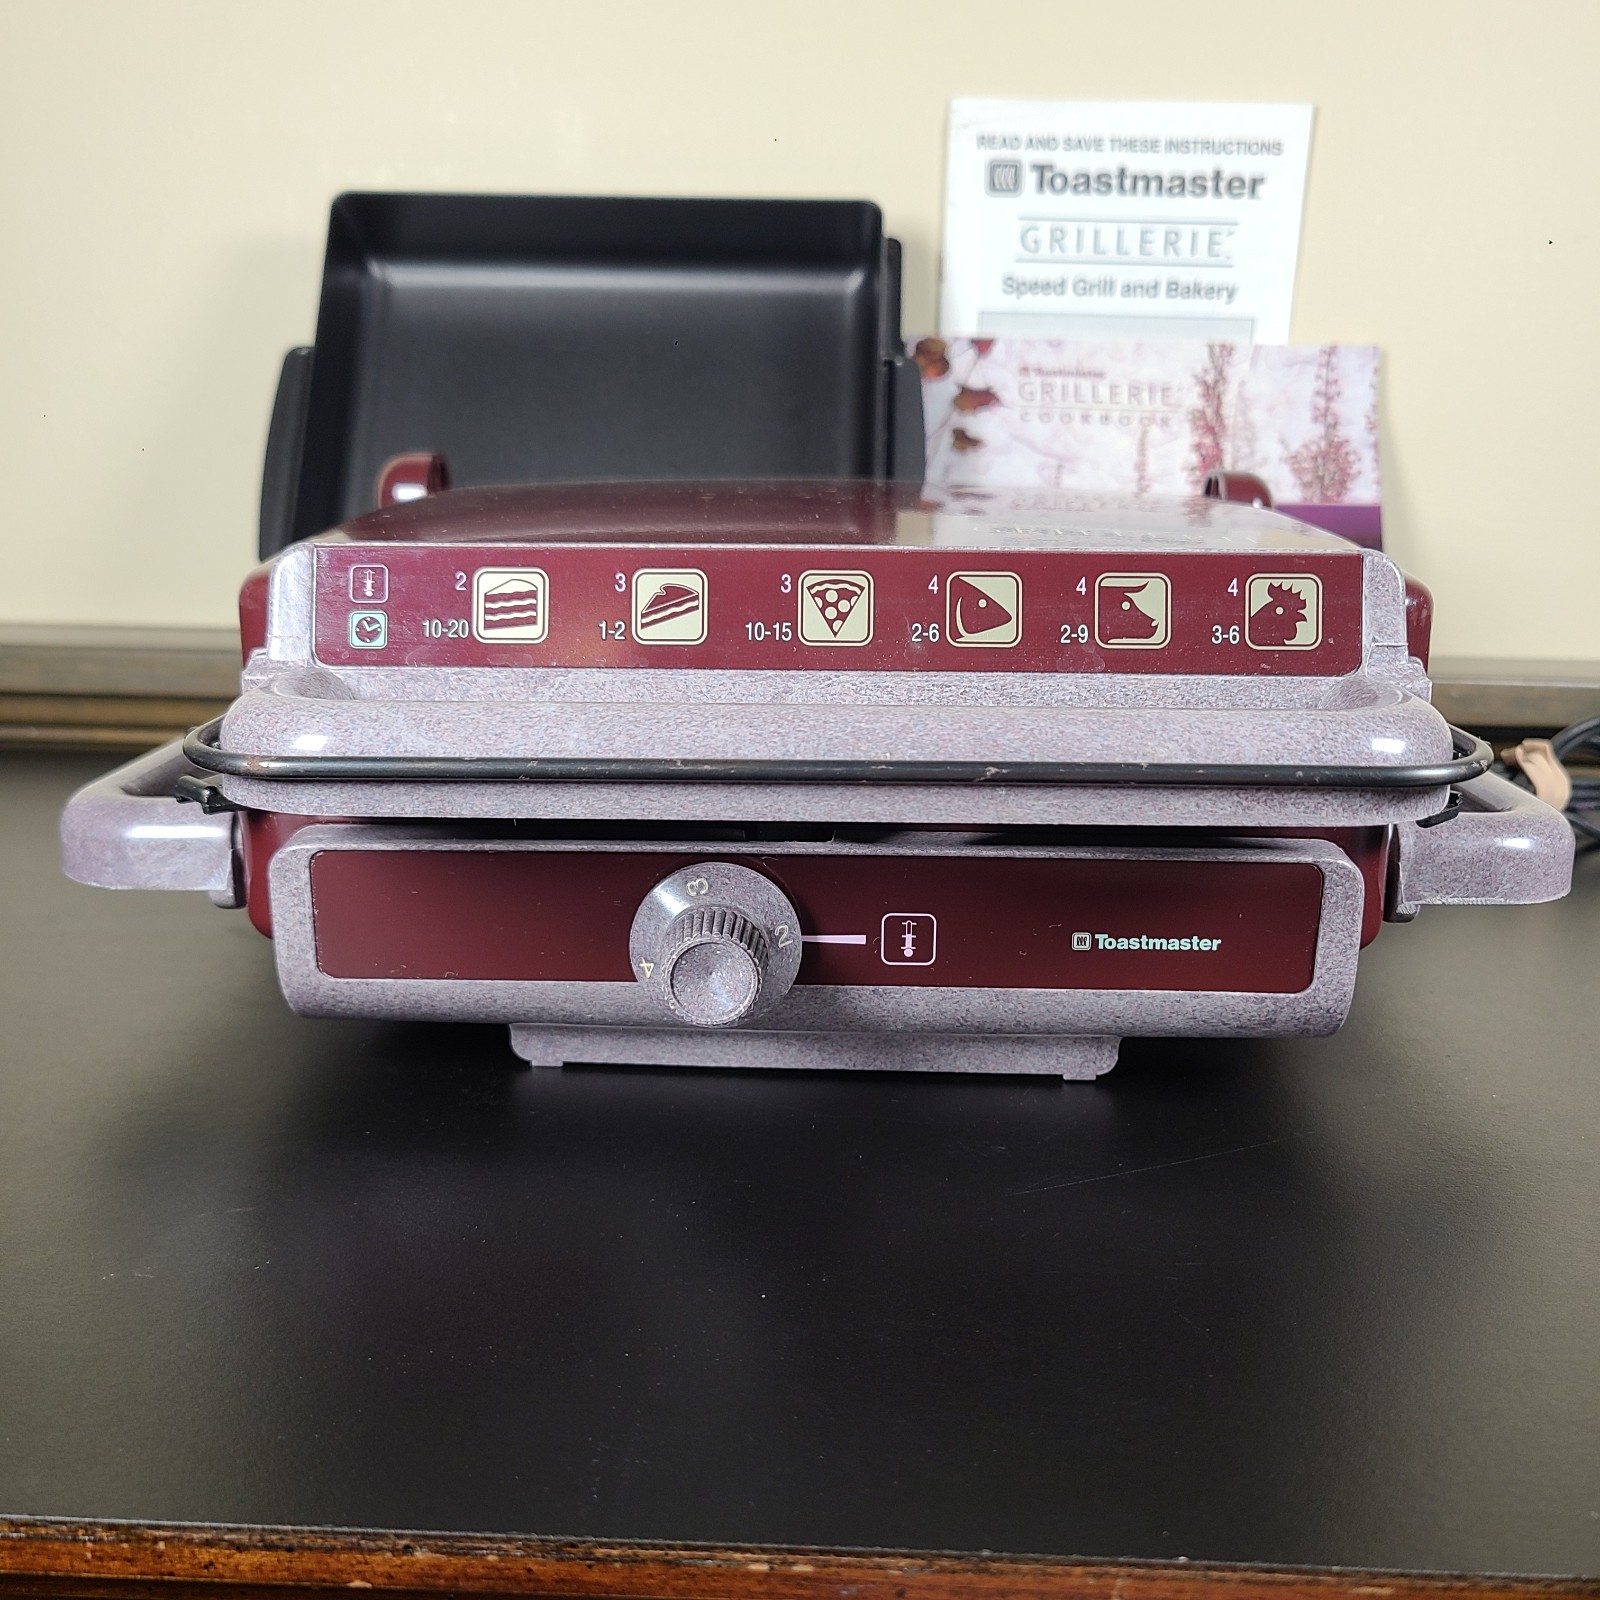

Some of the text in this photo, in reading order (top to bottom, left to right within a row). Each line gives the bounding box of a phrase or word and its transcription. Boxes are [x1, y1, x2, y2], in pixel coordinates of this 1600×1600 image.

[977, 134, 1283, 156] READ AND SAVE THESE INSTRUCTIONS
[1030, 163, 1265, 200] Toastmaster
[1019, 223, 1226, 259] GRILLERIE
[1002, 275, 1238, 305] Speed Grill and Bakery
[1018, 381, 1181, 407] GRILLERIE
[1020, 410, 1171, 427] COOKBOOK
[456, 573, 467, 591] 2
[614, 573, 626, 592] 3
[780, 574, 792, 593] 3
[928, 575, 939, 594] 4
[1076, 575, 1087, 595] 4
[1227, 577, 1239, 596] 4
[422, 620, 469, 640] 10-20
[599, 621, 626, 641] 1-2
[745, 622, 793, 642] 10-15
[911, 623, 940, 643] 2-6
[1060, 625, 1089, 644] 2-9
[1211, 626, 1240, 645] 3-6
[686, 877, 709, 897] 3
[774, 925, 794, 948] 2
[1095, 934, 1222, 951] Toastmaster
[639, 960, 655, 978] 4
